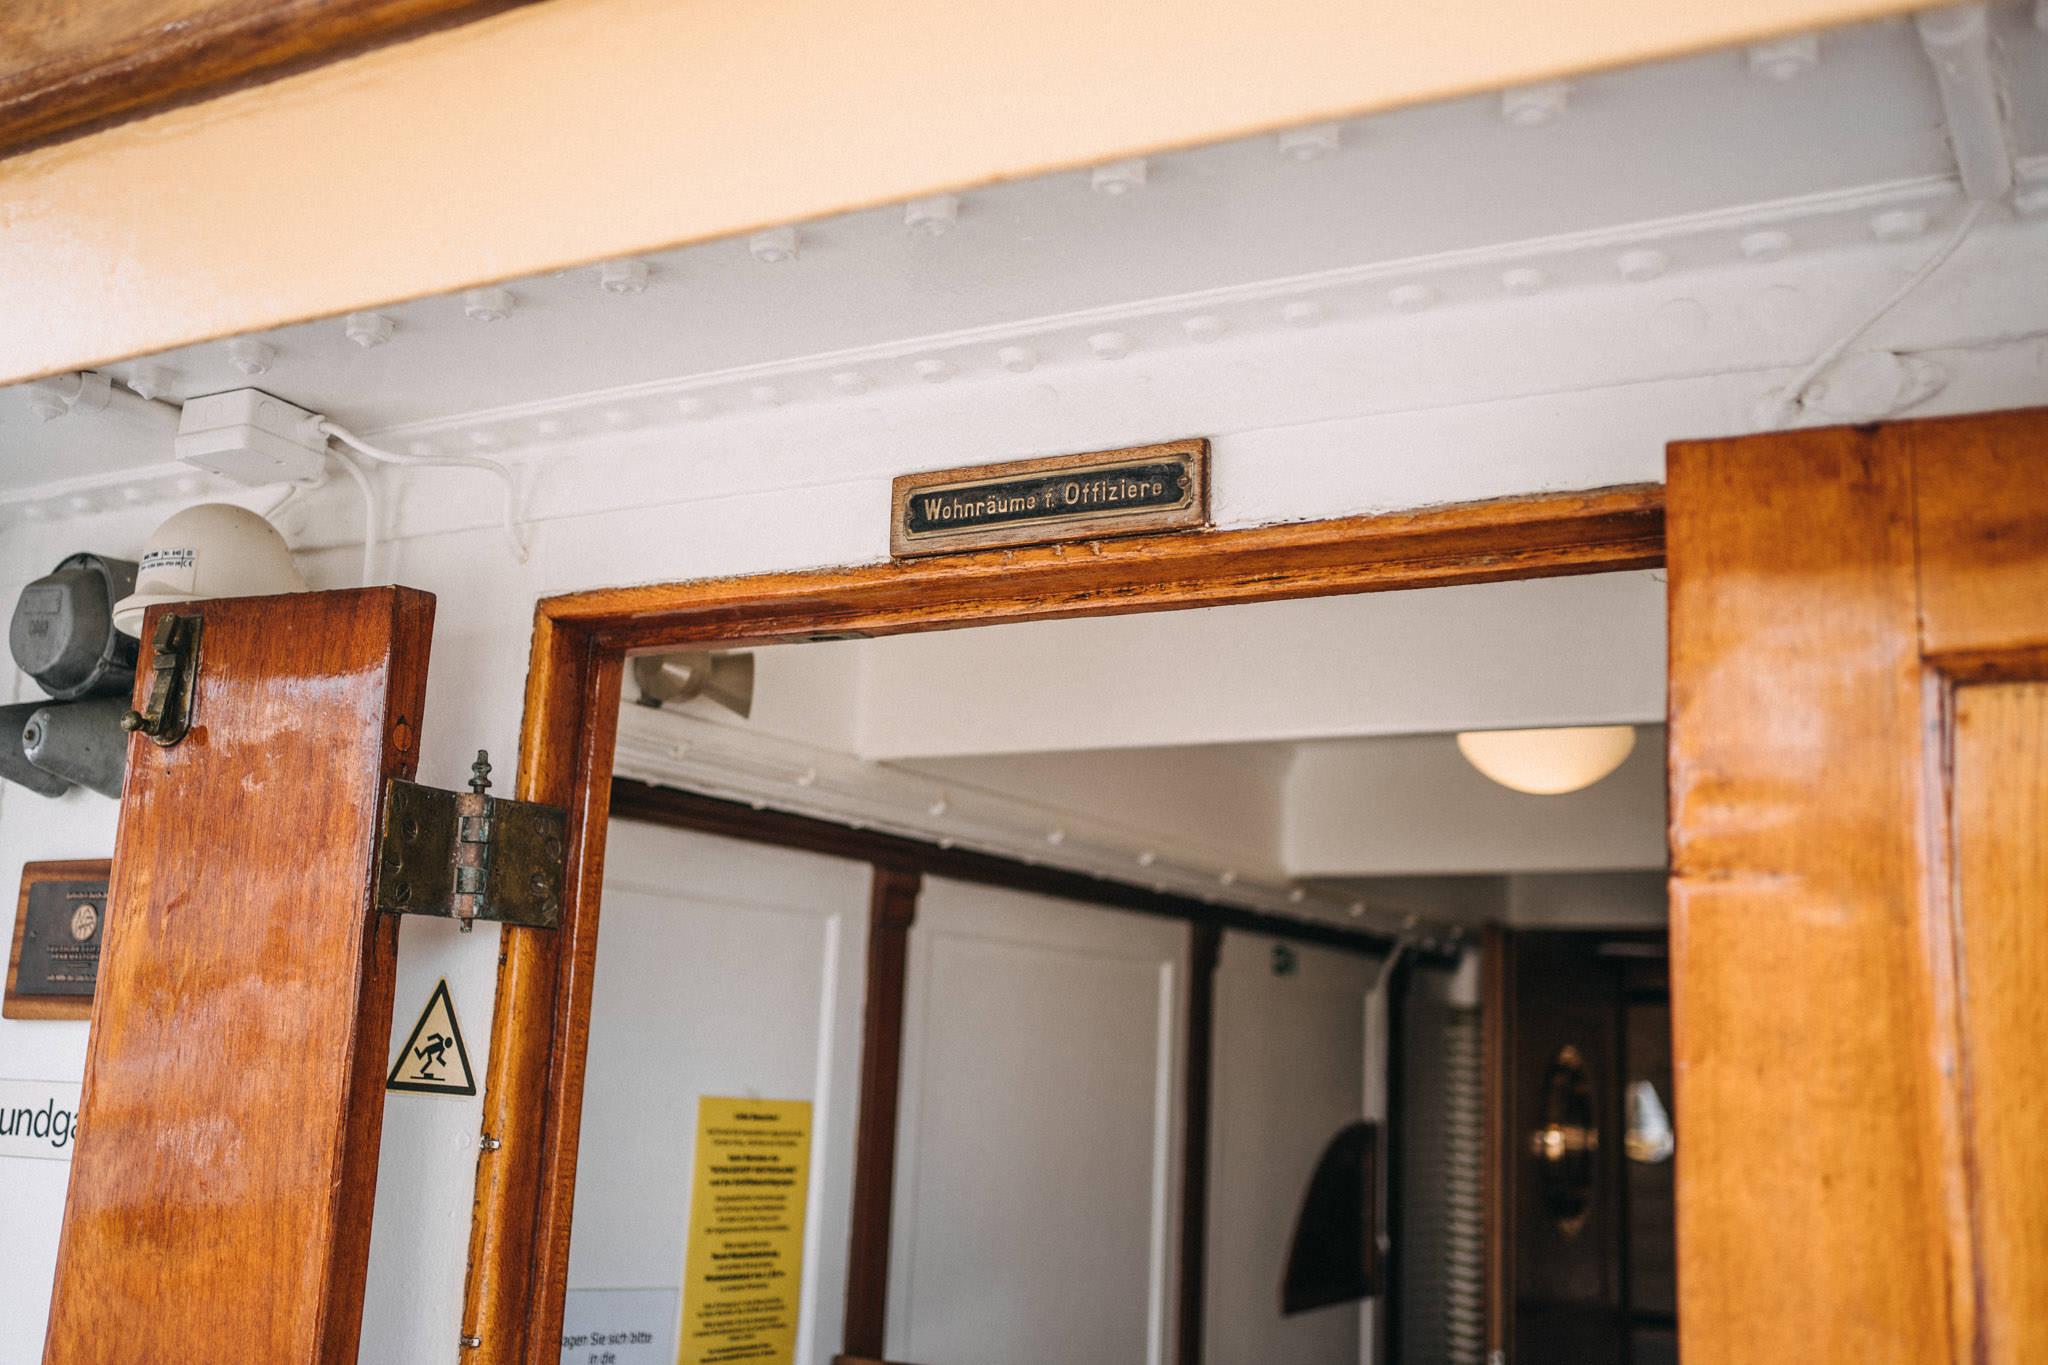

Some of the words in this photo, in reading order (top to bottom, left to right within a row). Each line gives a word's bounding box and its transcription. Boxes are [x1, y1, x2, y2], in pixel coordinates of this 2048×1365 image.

[923, 494, 1036, 521] Wohnräume
[1042, 489, 1055, 508] f.
[1063, 479, 1163, 505] Offiziere
